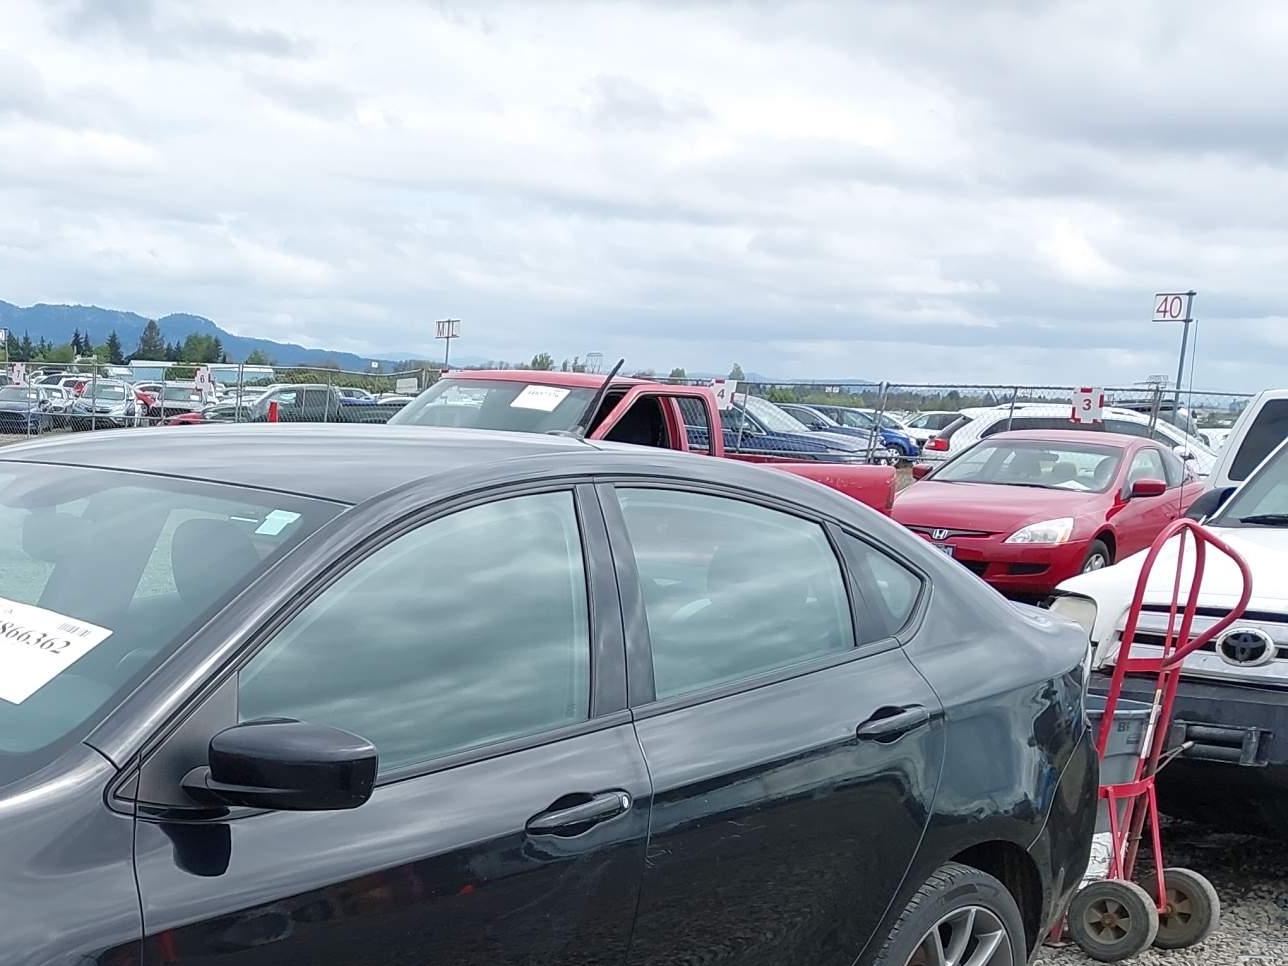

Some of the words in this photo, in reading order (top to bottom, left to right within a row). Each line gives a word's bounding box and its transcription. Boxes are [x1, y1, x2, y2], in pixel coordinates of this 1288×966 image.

[1156, 296, 1183, 319] 40
[717, 389, 725, 399] 4
[1082, 398, 1092, 411] 3
